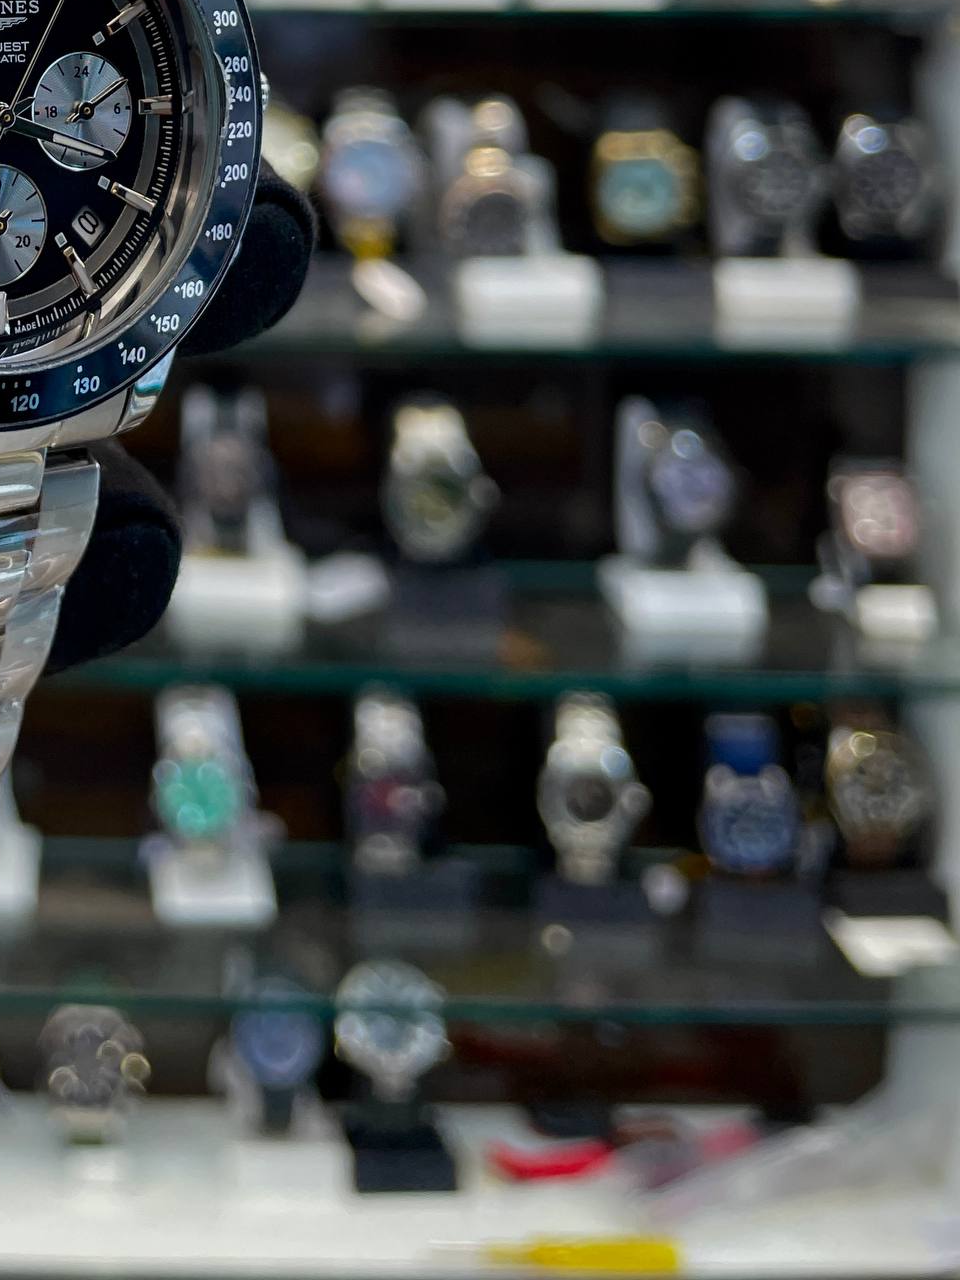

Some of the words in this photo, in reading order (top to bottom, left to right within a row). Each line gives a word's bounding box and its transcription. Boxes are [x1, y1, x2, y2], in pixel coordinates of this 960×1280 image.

[213, 10, 238, 28] 300
[73, 65, 90, 78] 24
[224, 56, 248, 73] 260
[229, 86, 252, 102] 240
[44, 105, 58, 118] 18
[113, 102, 122, 115] 6
[228, 121, 252, 139] 220
[224, 164, 248, 181] 200
[211, 223, 232, 241] 180
[15, 234, 32, 249] 20
[180, 280, 204, 298] 160
[14, 321, 37, 334] MADE
[155, 314, 179, 333] 150
[121, 346, 146, 365] 140
[73, 376, 100, 395] 130
[10, 393, 39, 411] 120
